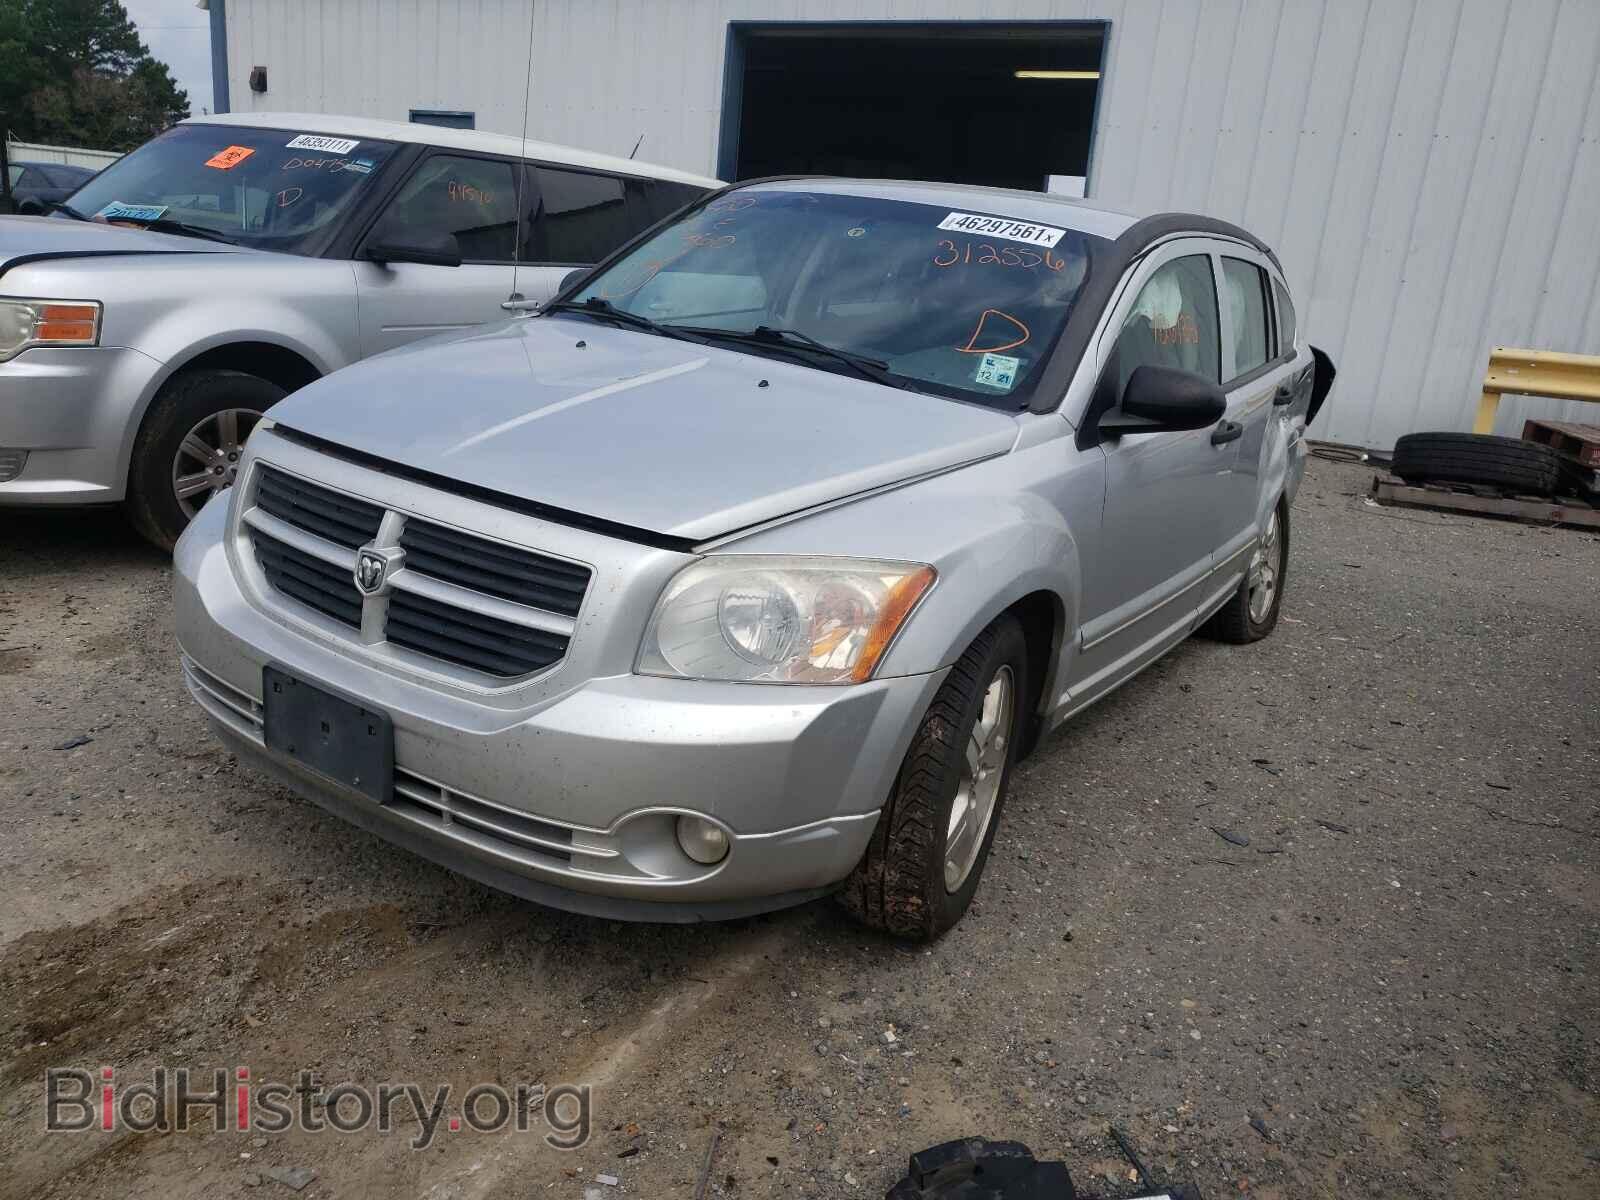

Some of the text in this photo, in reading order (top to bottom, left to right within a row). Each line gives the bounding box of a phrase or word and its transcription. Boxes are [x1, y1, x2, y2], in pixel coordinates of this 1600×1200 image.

[955, 216, 1044, 241] 46297561
[934, 240, 1065, 271] 312556
[953, 309, 1030, 352] D
[979, 370, 1010, 384] 12 21
